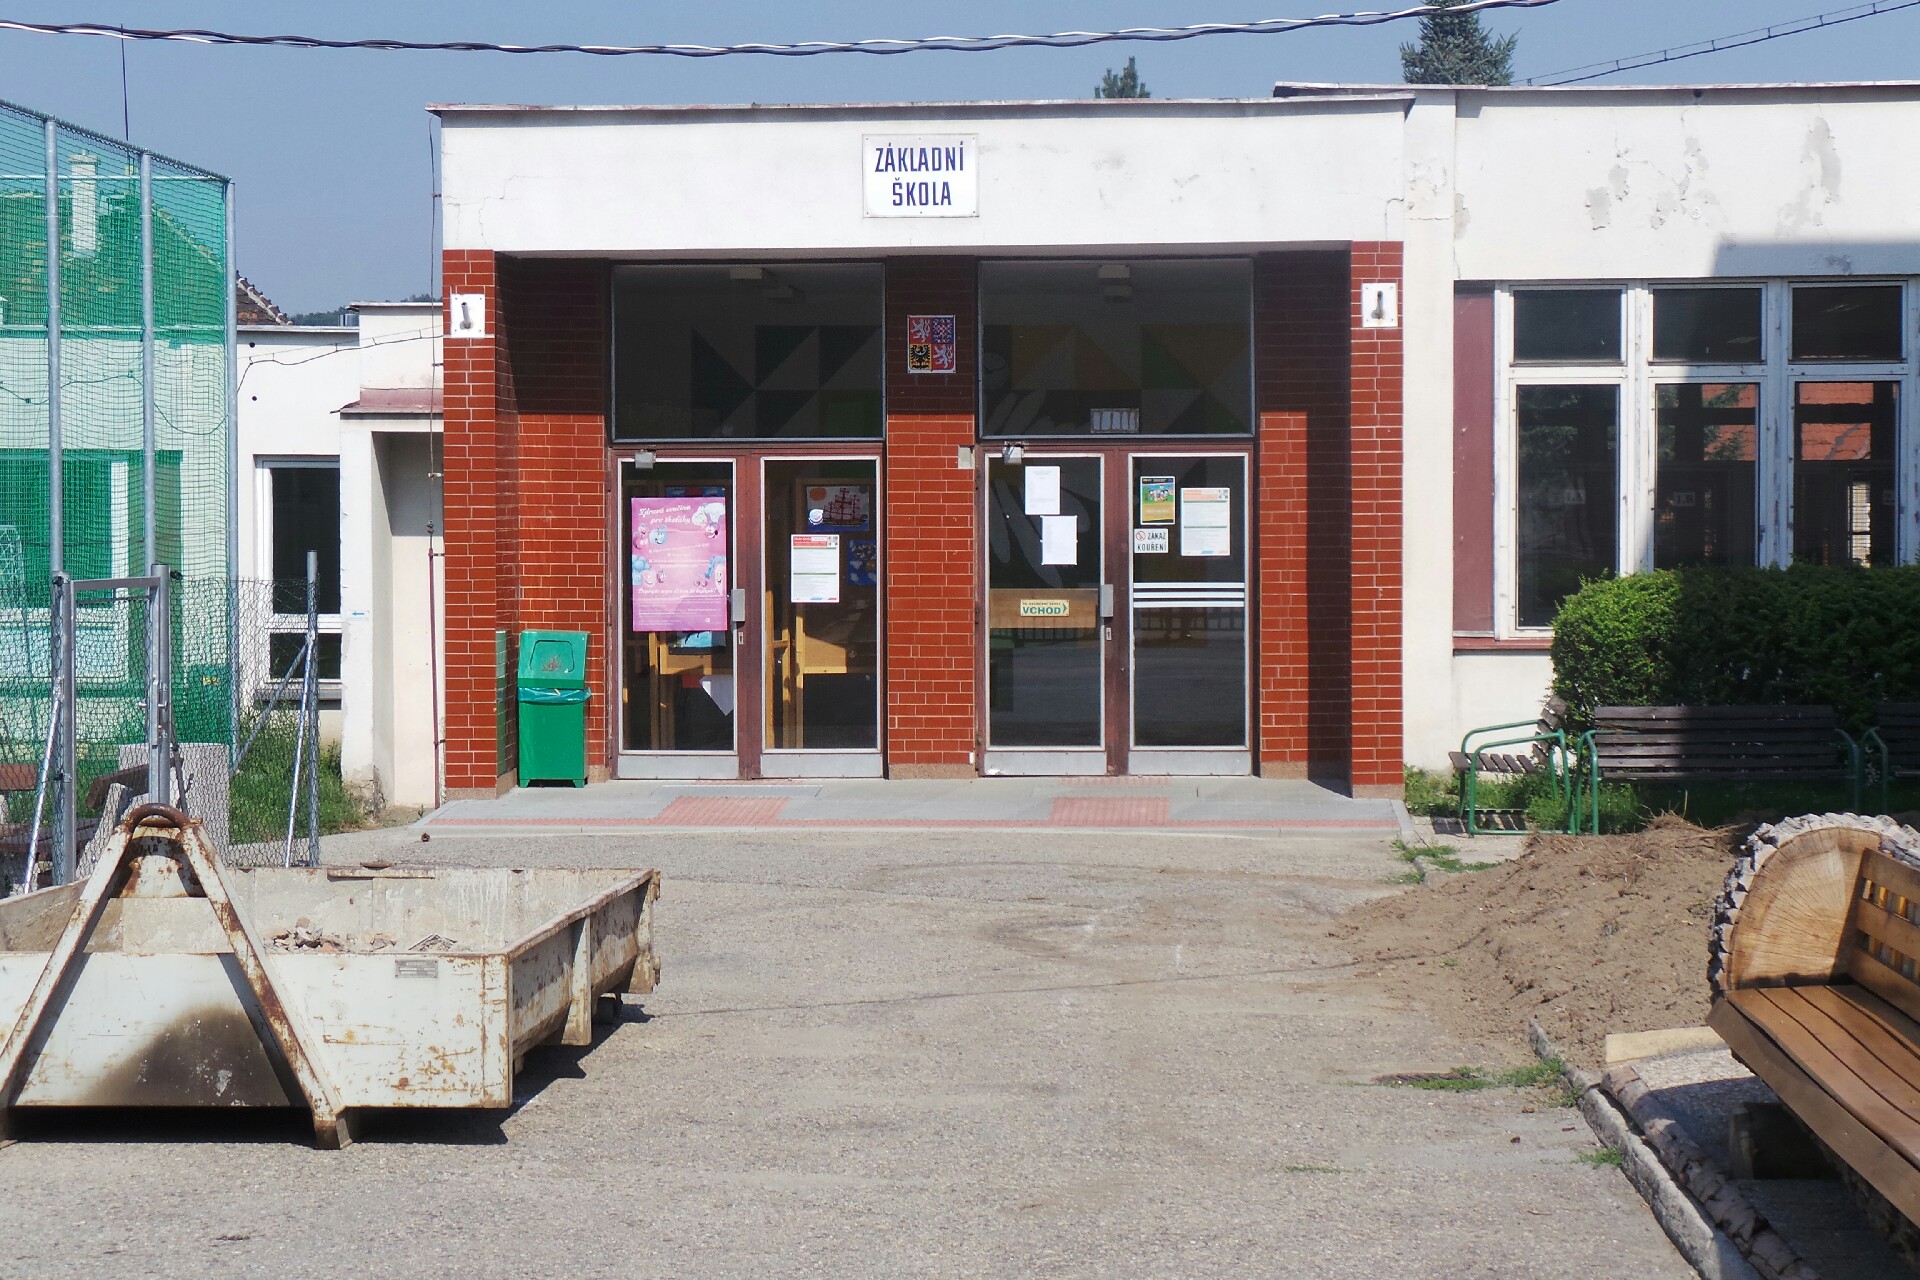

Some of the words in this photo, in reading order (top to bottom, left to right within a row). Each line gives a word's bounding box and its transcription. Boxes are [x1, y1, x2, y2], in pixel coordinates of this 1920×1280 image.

[875, 140, 964, 172] ZÁKLADNÍ
[892, 177, 952, 206] ŠKOLA
[1147, 531, 1166, 540] ZÁKAZ
[1137, 541, 1167, 551] KOUŘENÍ
[1022, 606, 1061, 614] VCHOD
